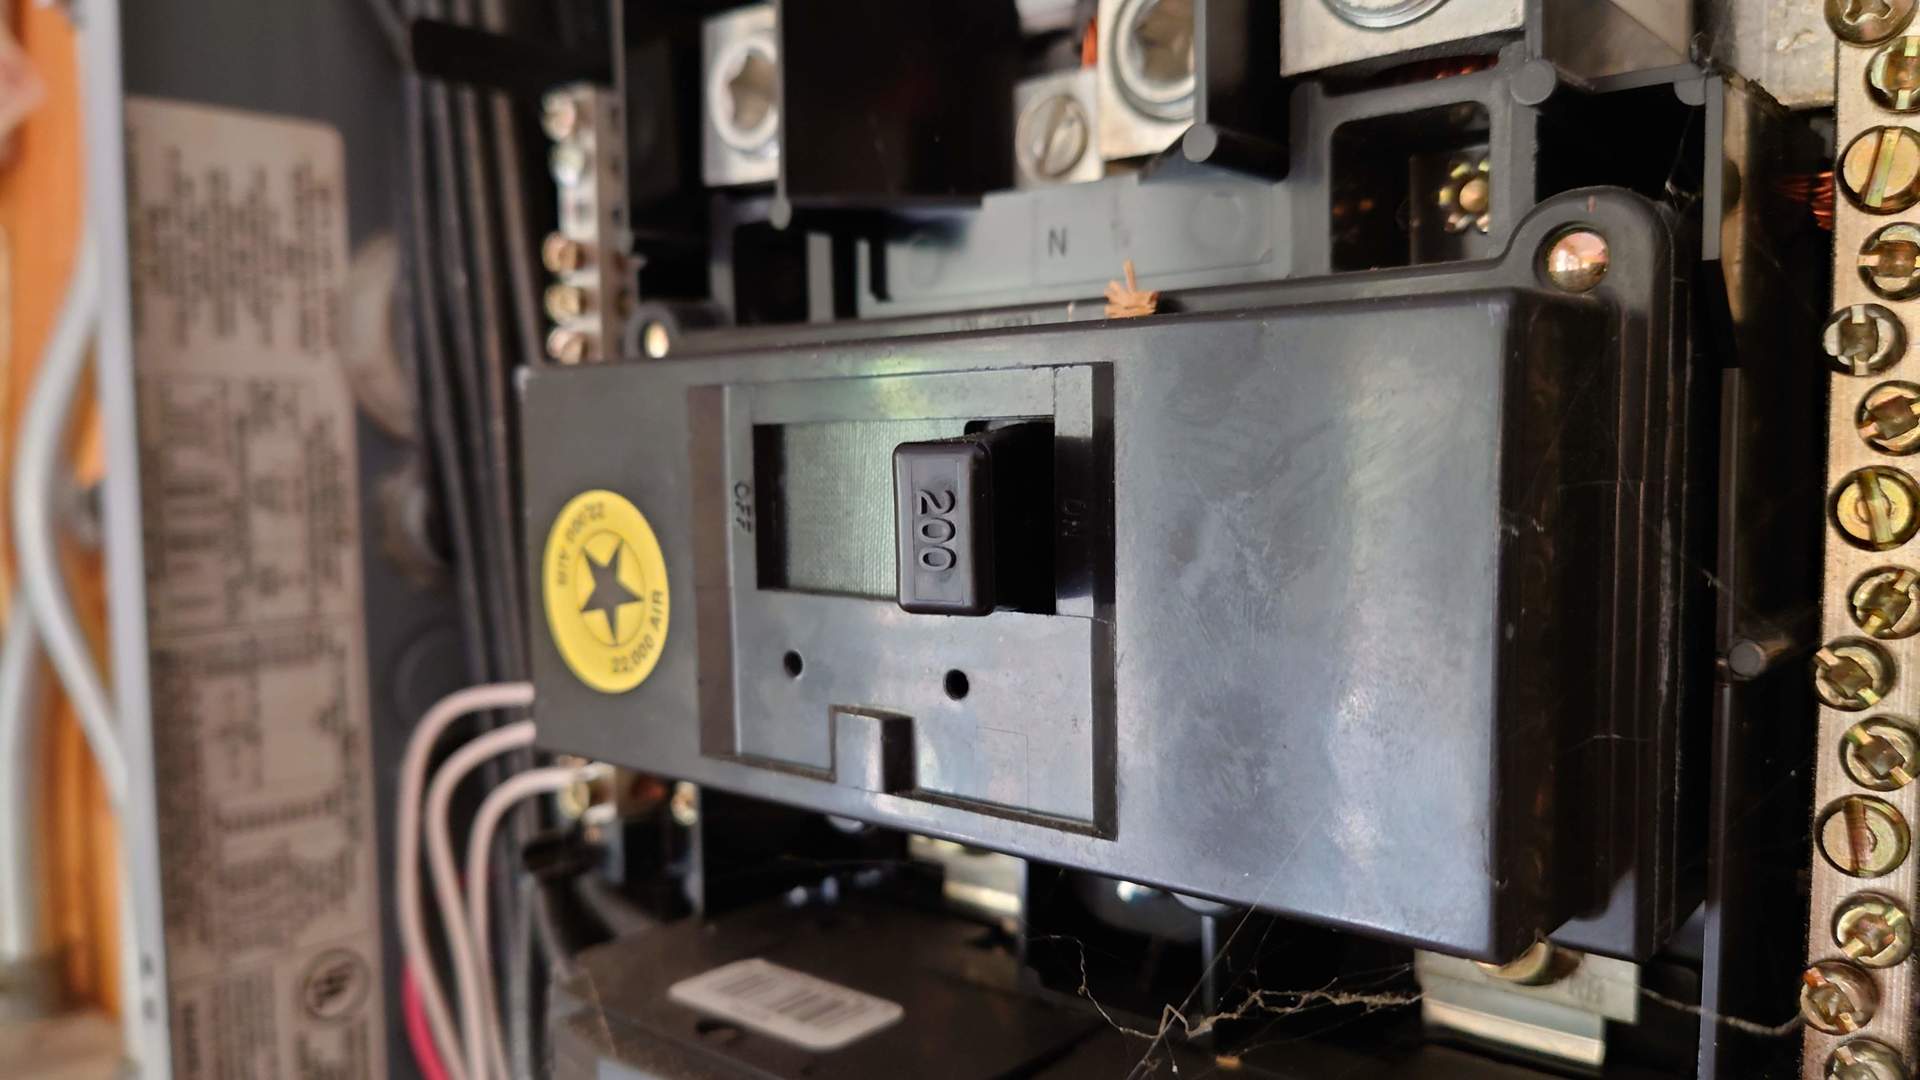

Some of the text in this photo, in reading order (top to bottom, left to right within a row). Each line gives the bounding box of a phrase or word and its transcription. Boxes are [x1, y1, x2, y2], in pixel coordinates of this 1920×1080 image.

[734, 481, 751, 533] OFF
[919, 488, 957, 572] 200
[611, 590, 665, 673] 22,000 AIR
